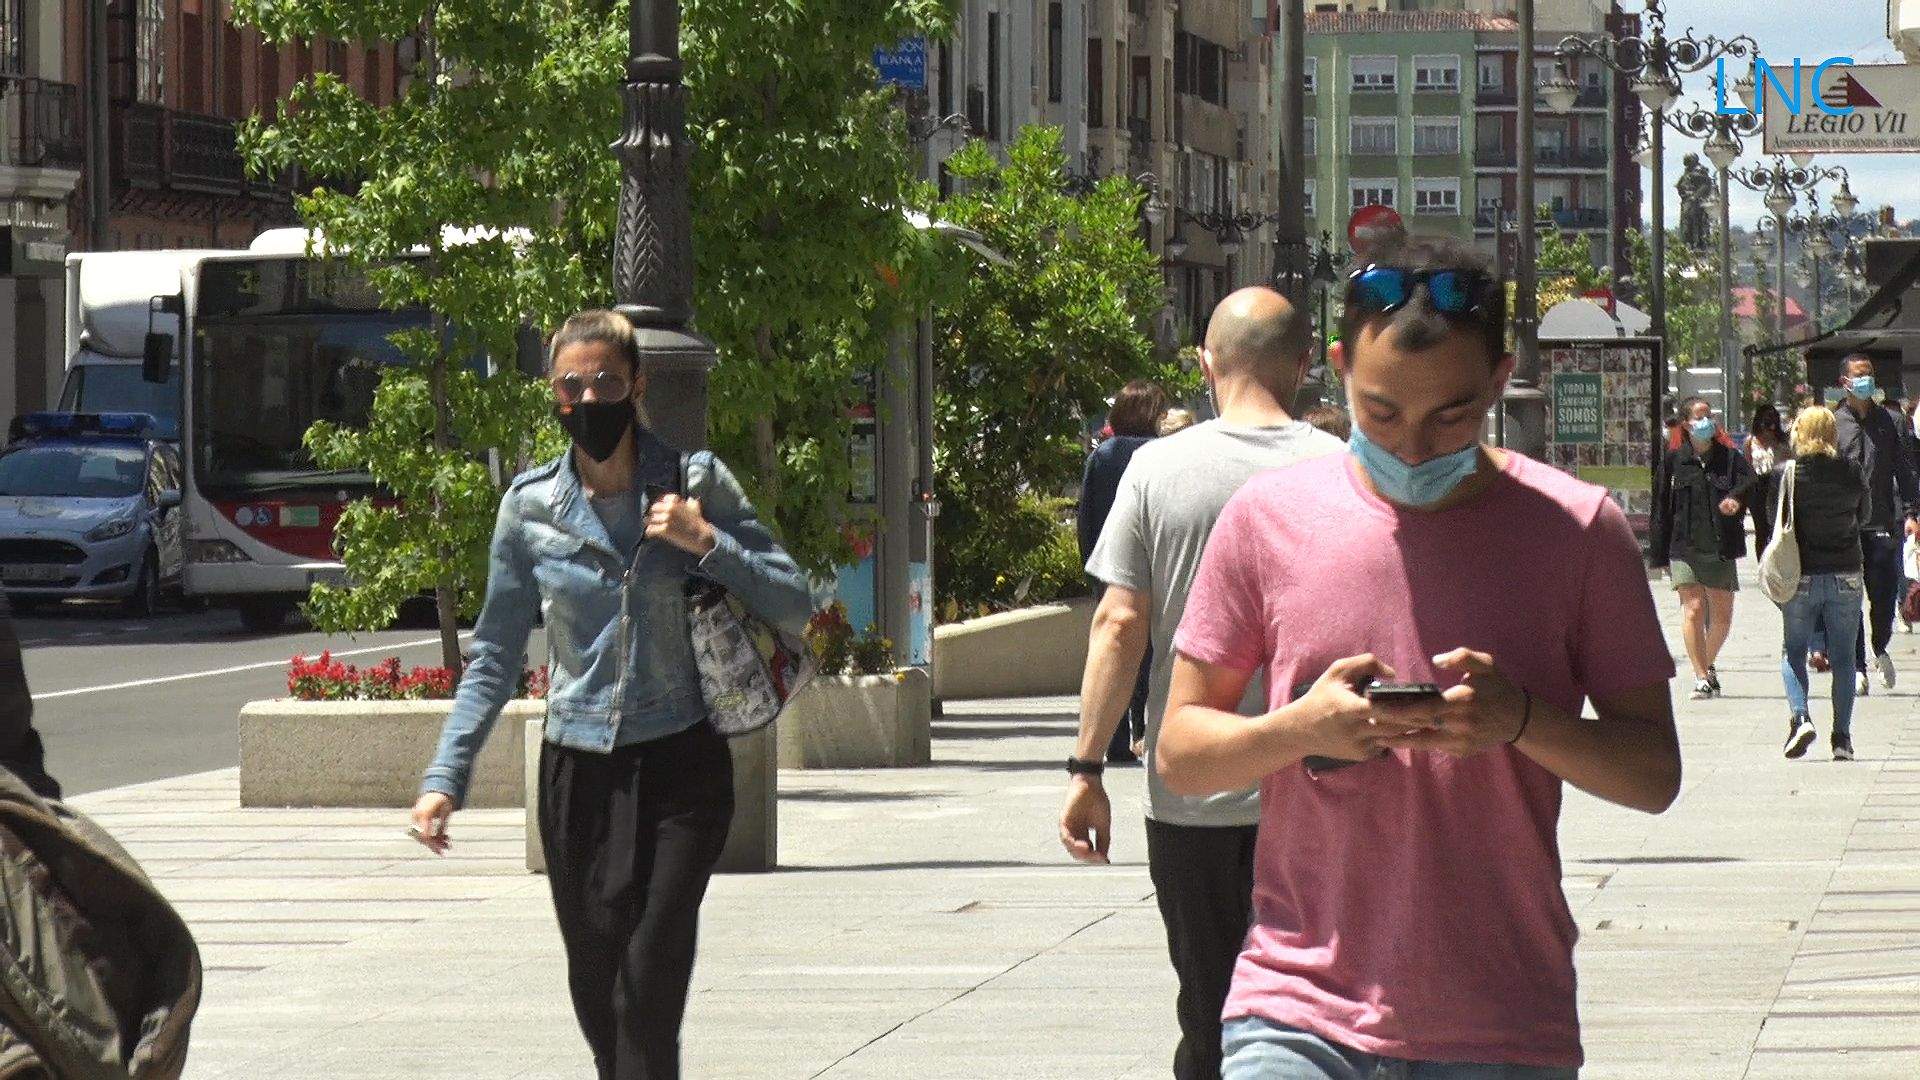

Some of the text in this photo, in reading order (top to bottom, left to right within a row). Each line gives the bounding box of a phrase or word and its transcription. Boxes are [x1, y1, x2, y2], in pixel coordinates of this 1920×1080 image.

[1787, 109, 1908, 133] LEGIO VII
[1558, 406, 1598, 423] SOMOS
